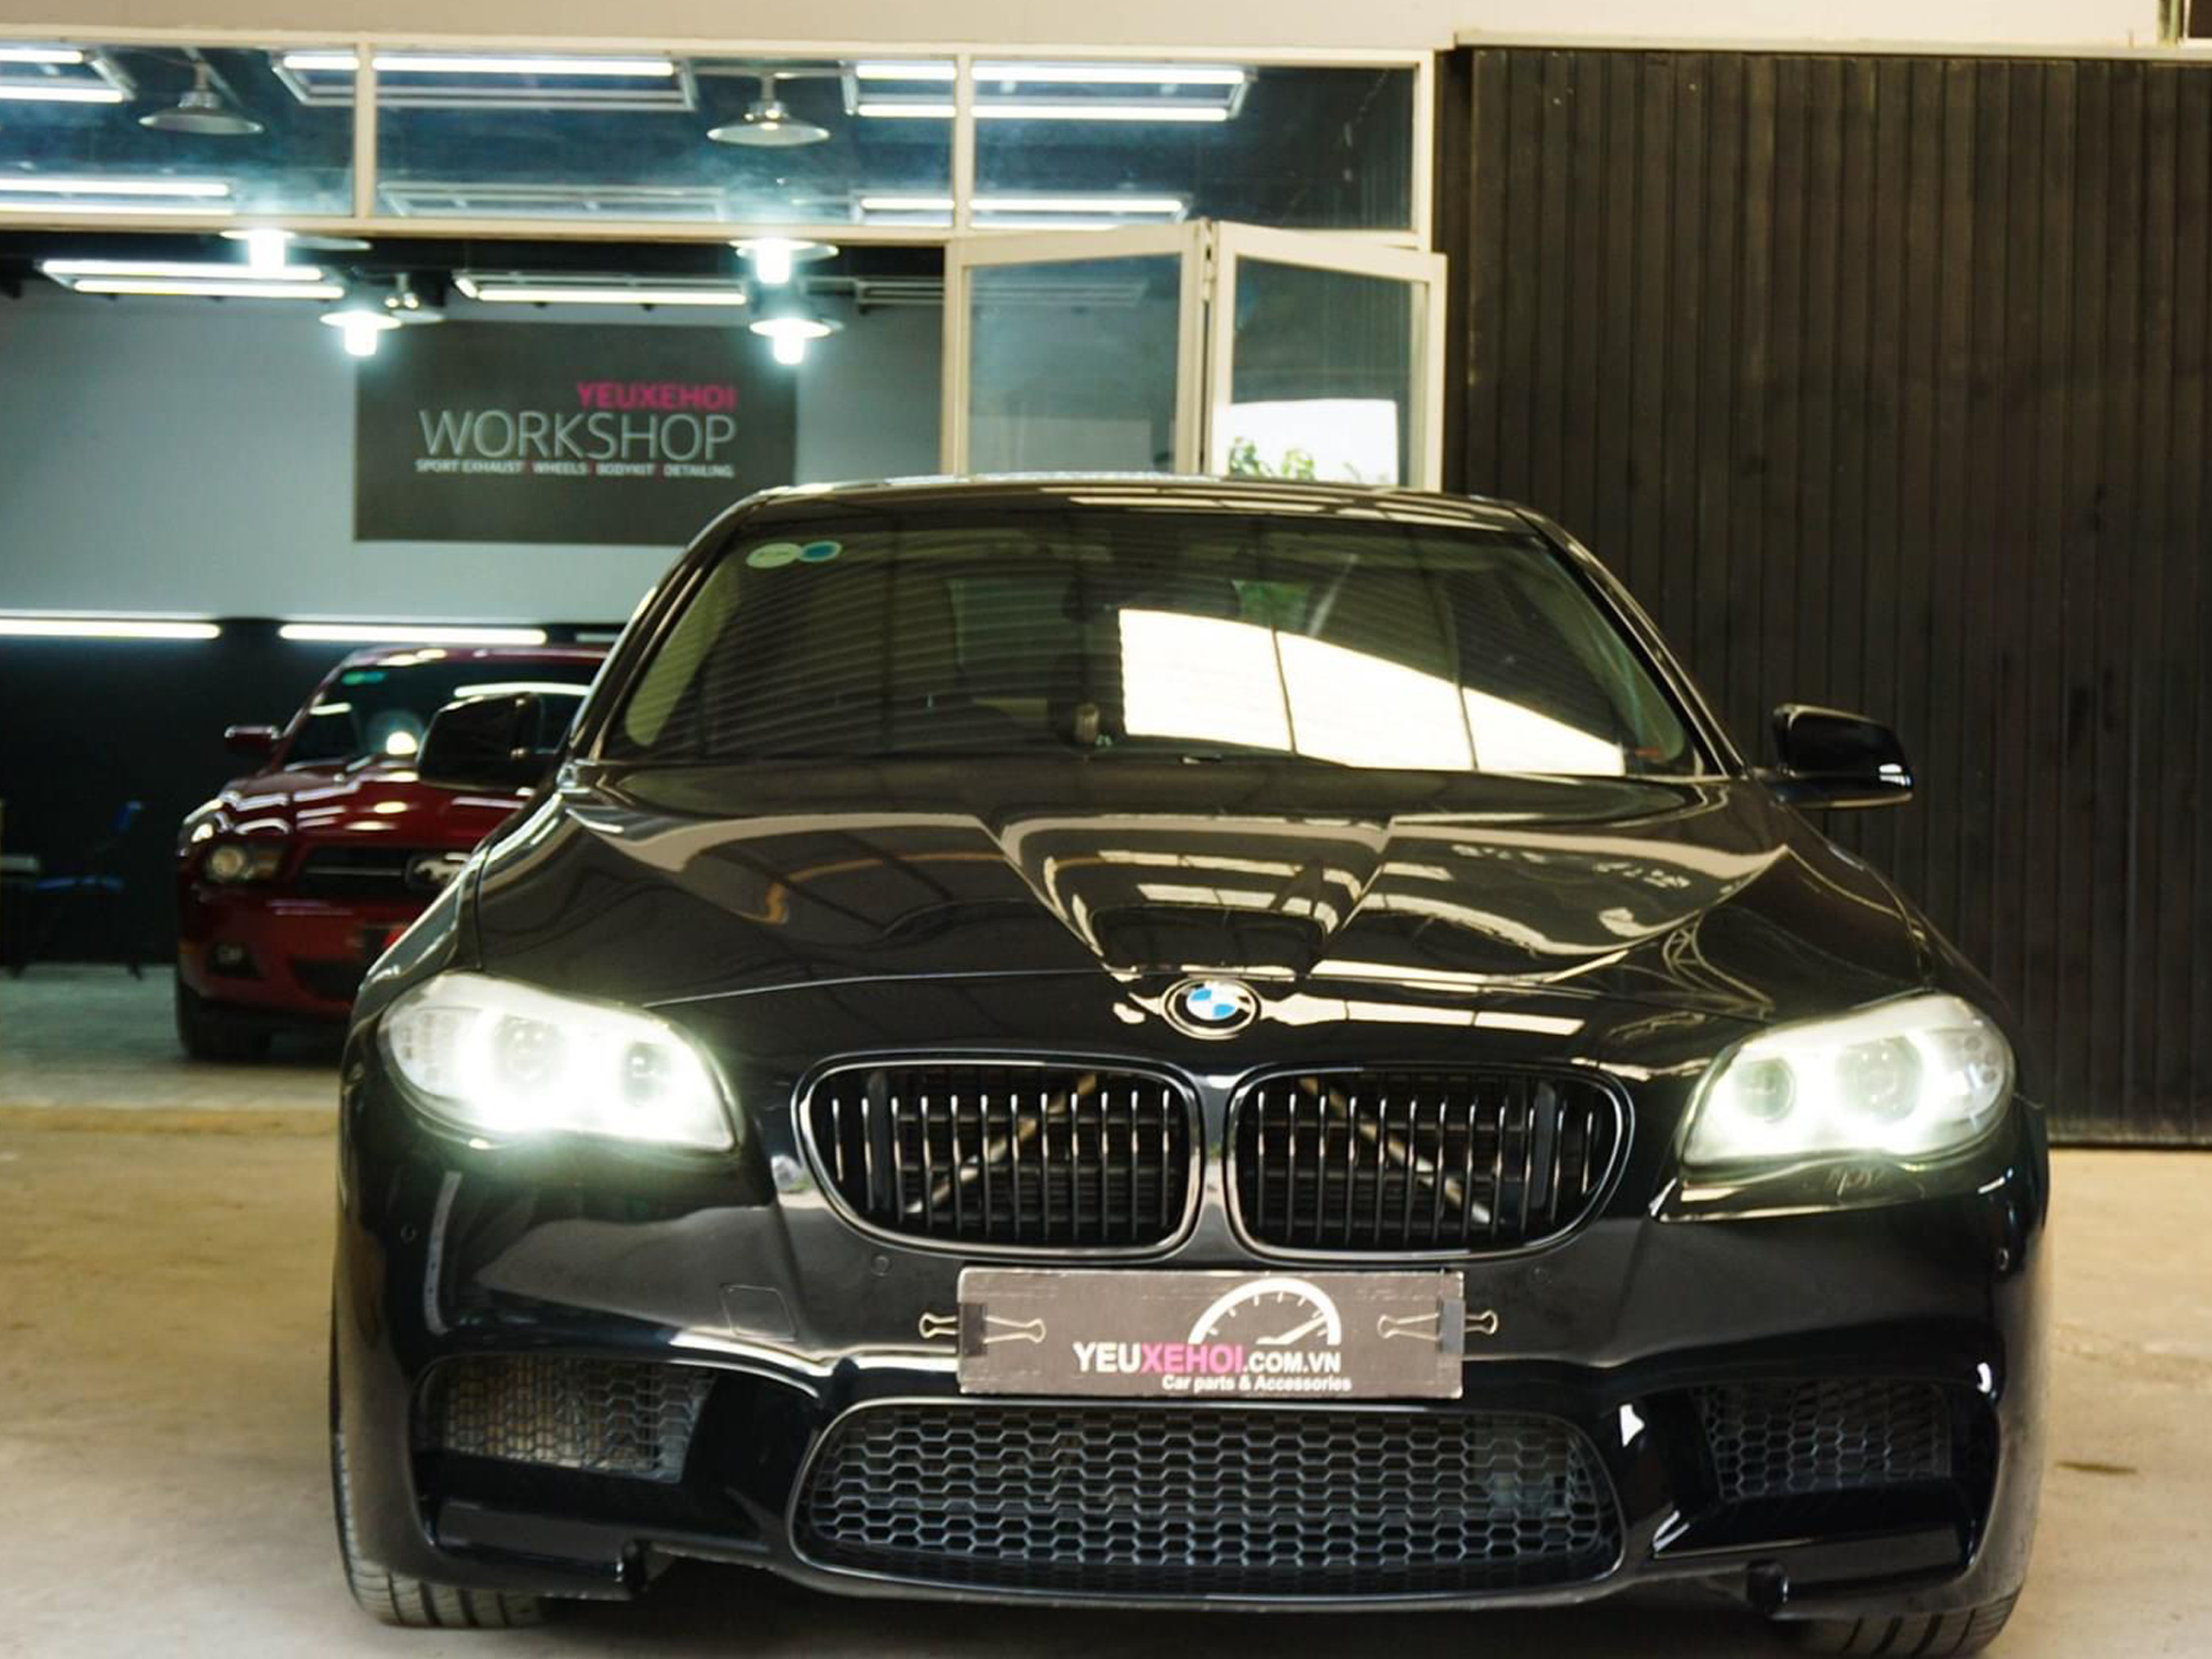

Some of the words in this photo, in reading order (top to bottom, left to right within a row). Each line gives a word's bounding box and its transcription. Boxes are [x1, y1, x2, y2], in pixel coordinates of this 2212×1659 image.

[578, 383, 737, 410] YEUXEHOI
[419, 410, 737, 461] WORKSHOP
[416, 459, 460, 474] SPORT
[461, 460, 524, 474] EXHAUST
[531, 461, 588, 475] WHEELS
[1072, 1342, 1341, 1374] YEUXEHOI.COM.VN
[1161, 1374, 1192, 1390] Car
[1193, 1376, 1236, 1395] parts
[1238, 1375, 1253, 1391] &
[1254, 1375, 1352, 1392] Accessories
